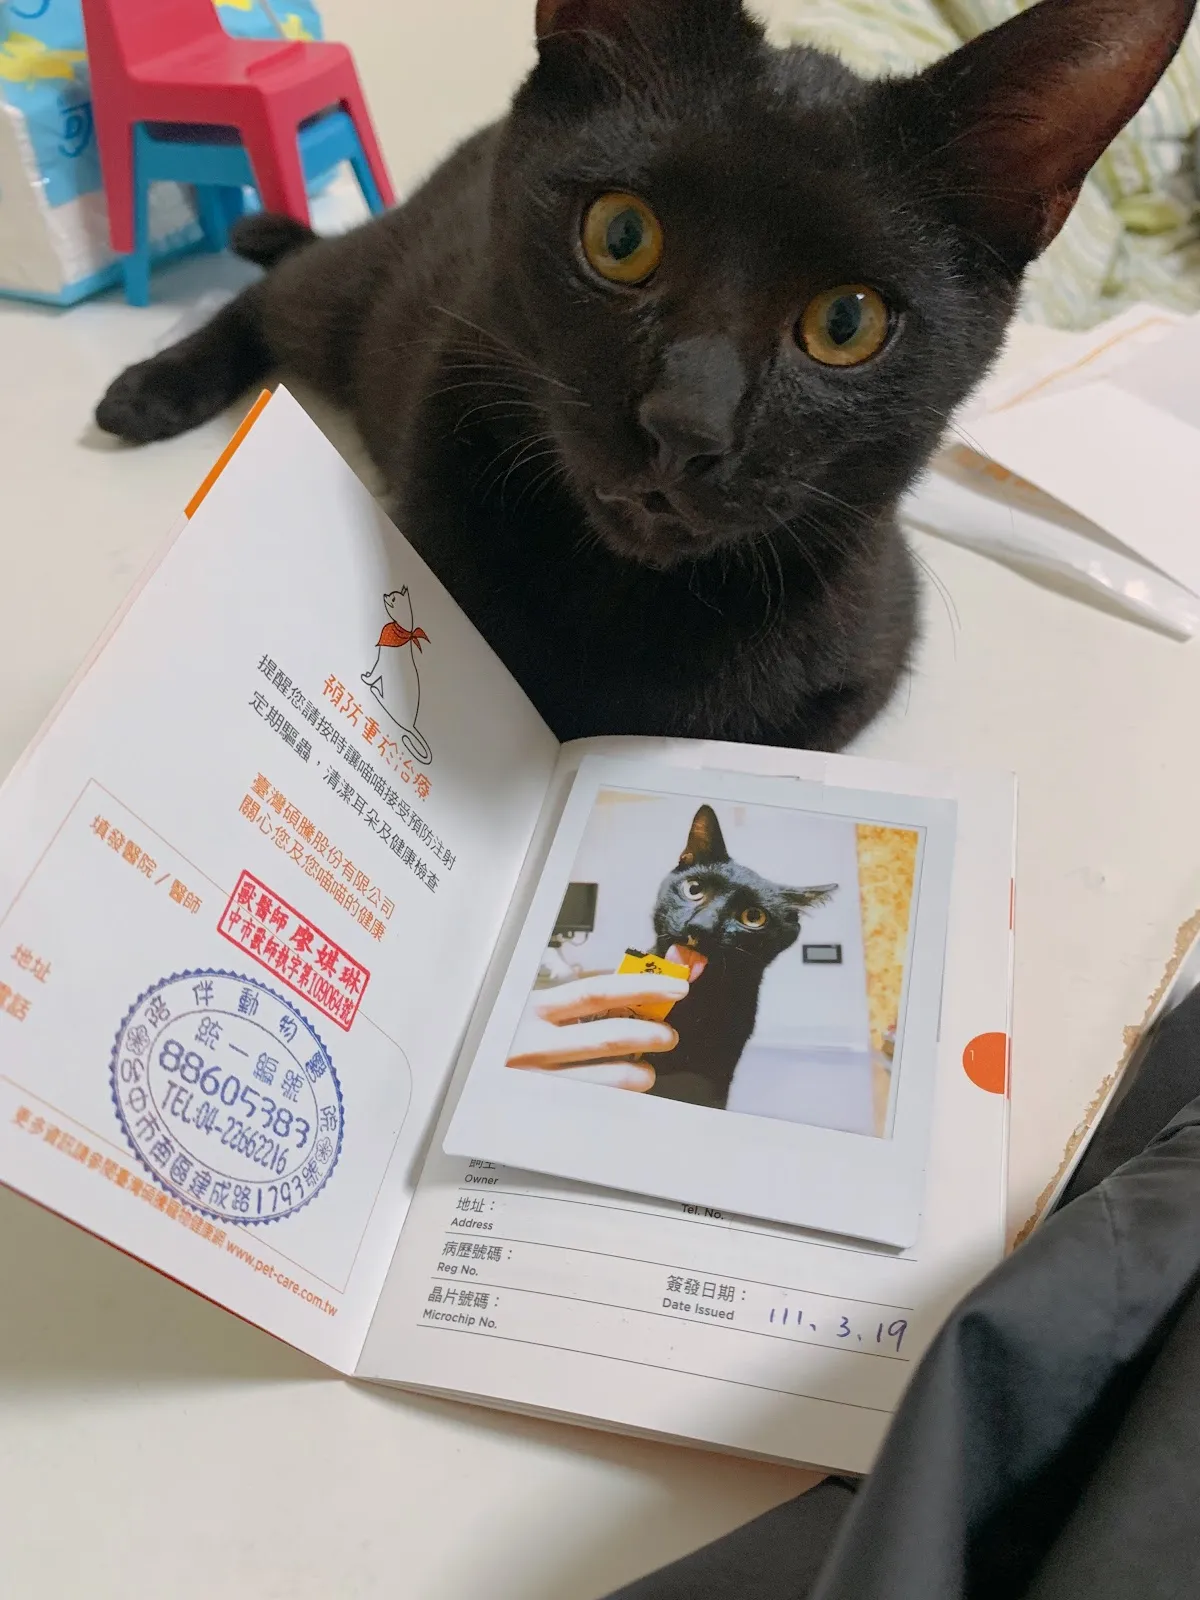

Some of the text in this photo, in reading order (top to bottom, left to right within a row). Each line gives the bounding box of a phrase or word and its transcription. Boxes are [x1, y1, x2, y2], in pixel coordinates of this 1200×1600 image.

[256, 653, 458, 871] 提醒您請按時讓喵喵接受預防注射
[322, 673, 433, 802] 預防重於治療
[238, 793, 388, 943] 關心您及您喵喵的健康
[250, 771, 396, 921] 臺灣碩騰股份有限公司
[10, 943, 52, 984] 地址
[194, 1016, 305, 1103] 統一編號
[158, 1038, 310, 1149] 88605383
[464, 1173, 499, 1185] Owner
[450, 1217, 493, 1231] Address
[681, 1203, 725, 1220] Tel. No.
[226, 1239, 338, 1318] www.pet-care.com.tw
[437, 1262, 479, 1277] Reg No.
[422, 1309, 498, 1330] Microchip No.
[662, 1297, 735, 1321] Date Issued
